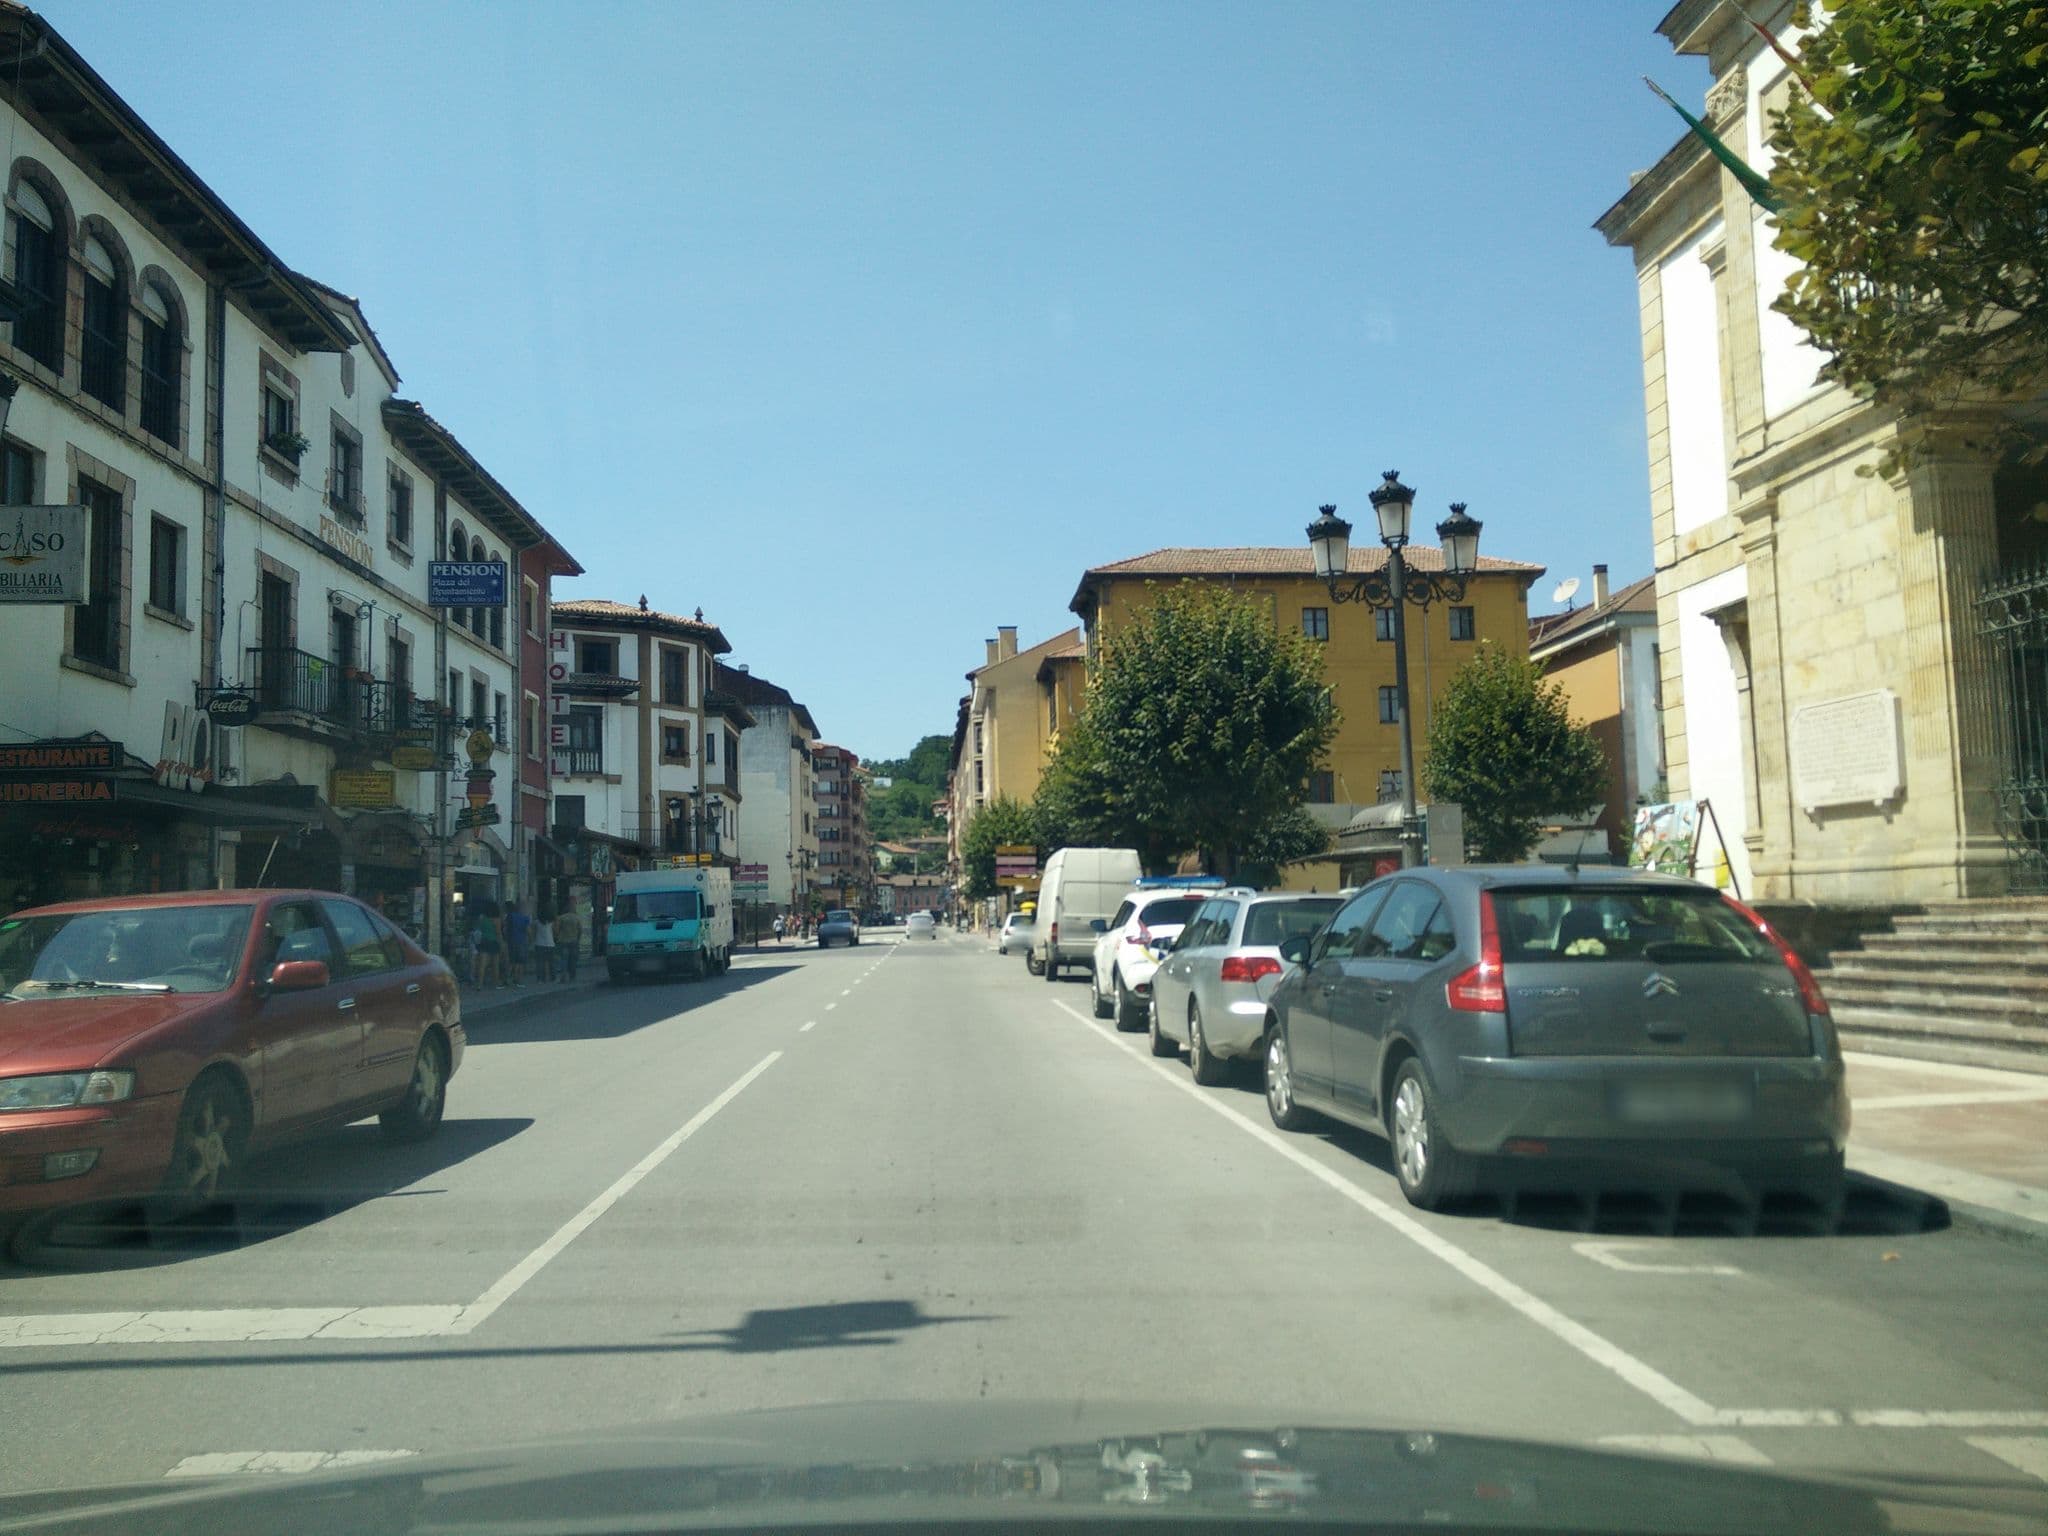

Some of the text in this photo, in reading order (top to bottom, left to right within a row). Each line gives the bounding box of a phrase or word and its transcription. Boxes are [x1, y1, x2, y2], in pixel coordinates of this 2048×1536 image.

[432, 564, 502, 577] PENSION
[0, 572, 62, 587] BILIARIA
[432, 578, 470, 586] Plaza del
[432, 587, 486, 597] Ayuntamiento
[549, 632, 566, 776] HOTEL
[0, 782, 111, 801] IDRERIA
